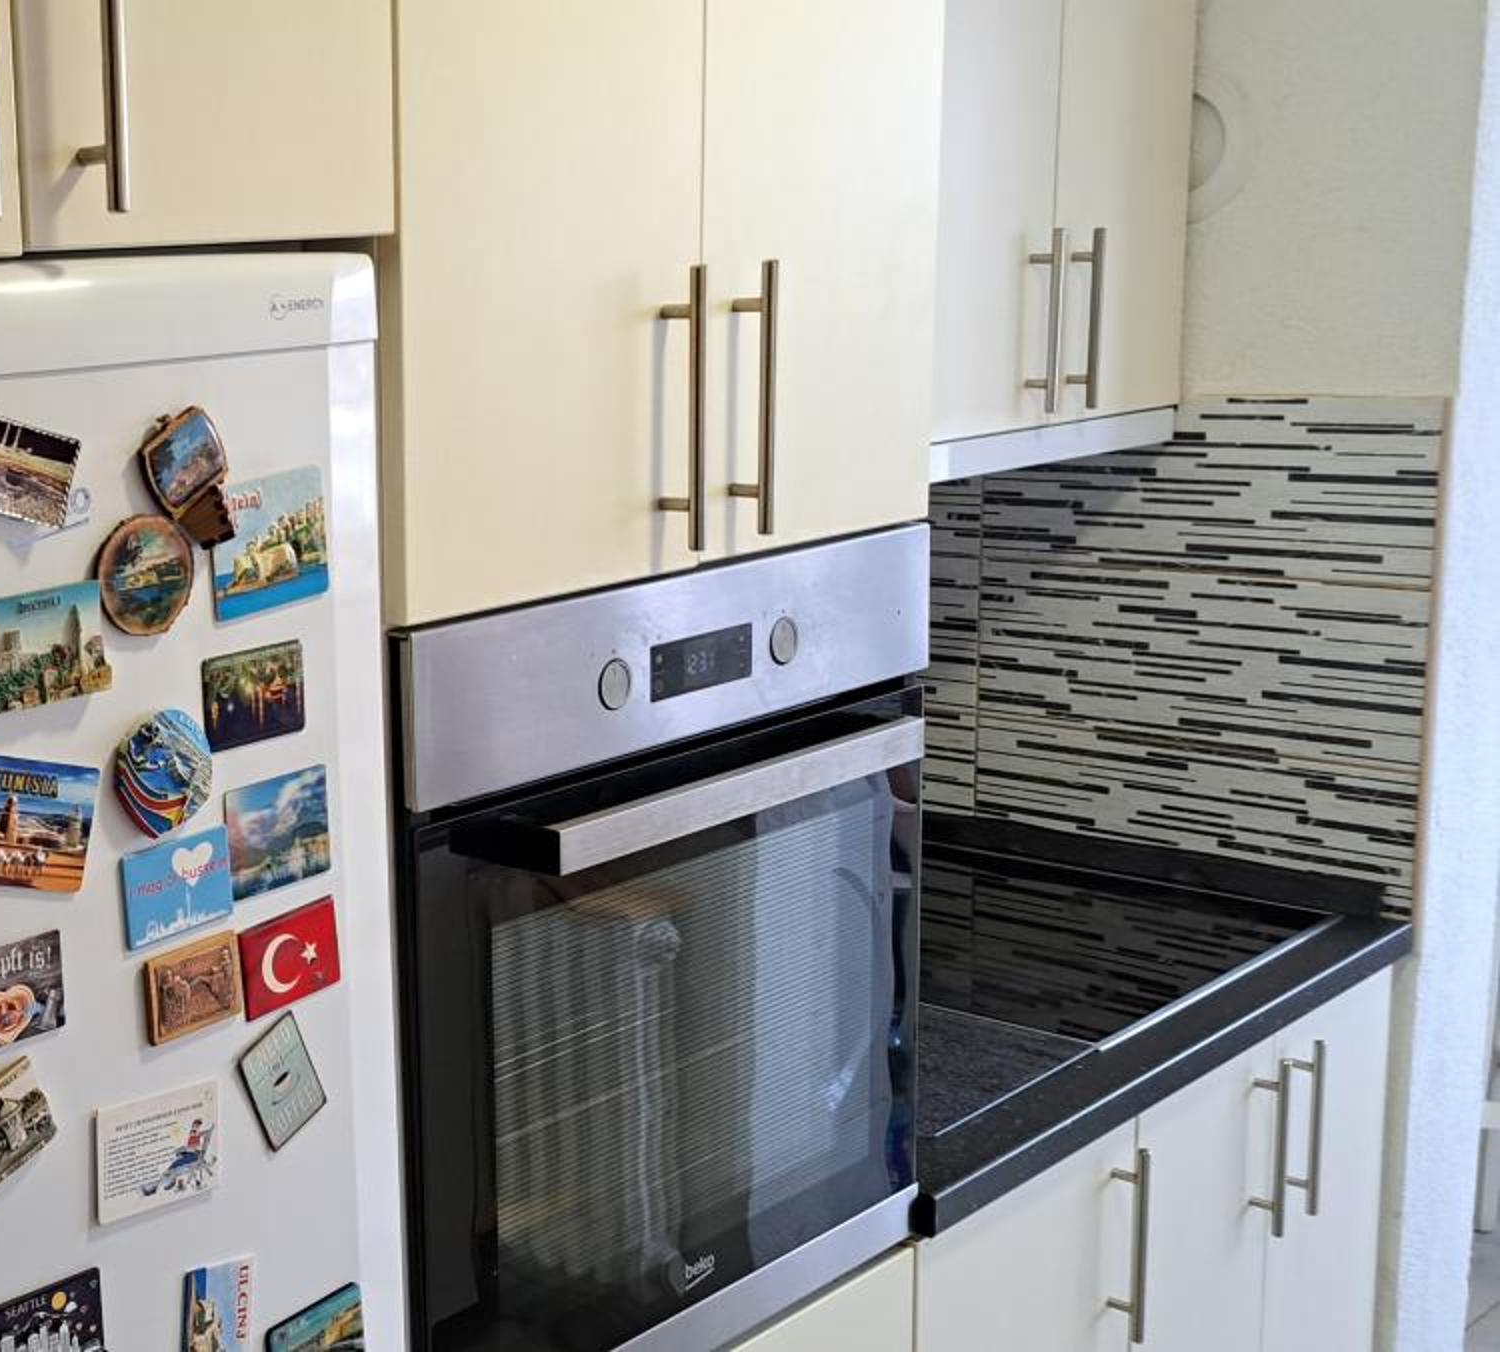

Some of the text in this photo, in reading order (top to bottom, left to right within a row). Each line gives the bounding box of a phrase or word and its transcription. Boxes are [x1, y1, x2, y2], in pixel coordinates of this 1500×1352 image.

[29, 945, 51, 970] is!
[685, 1254, 716, 1279] beko
[4, 1295, 48, 1319] SEATTLE
[236, 1265, 249, 1339] ULCINJ
